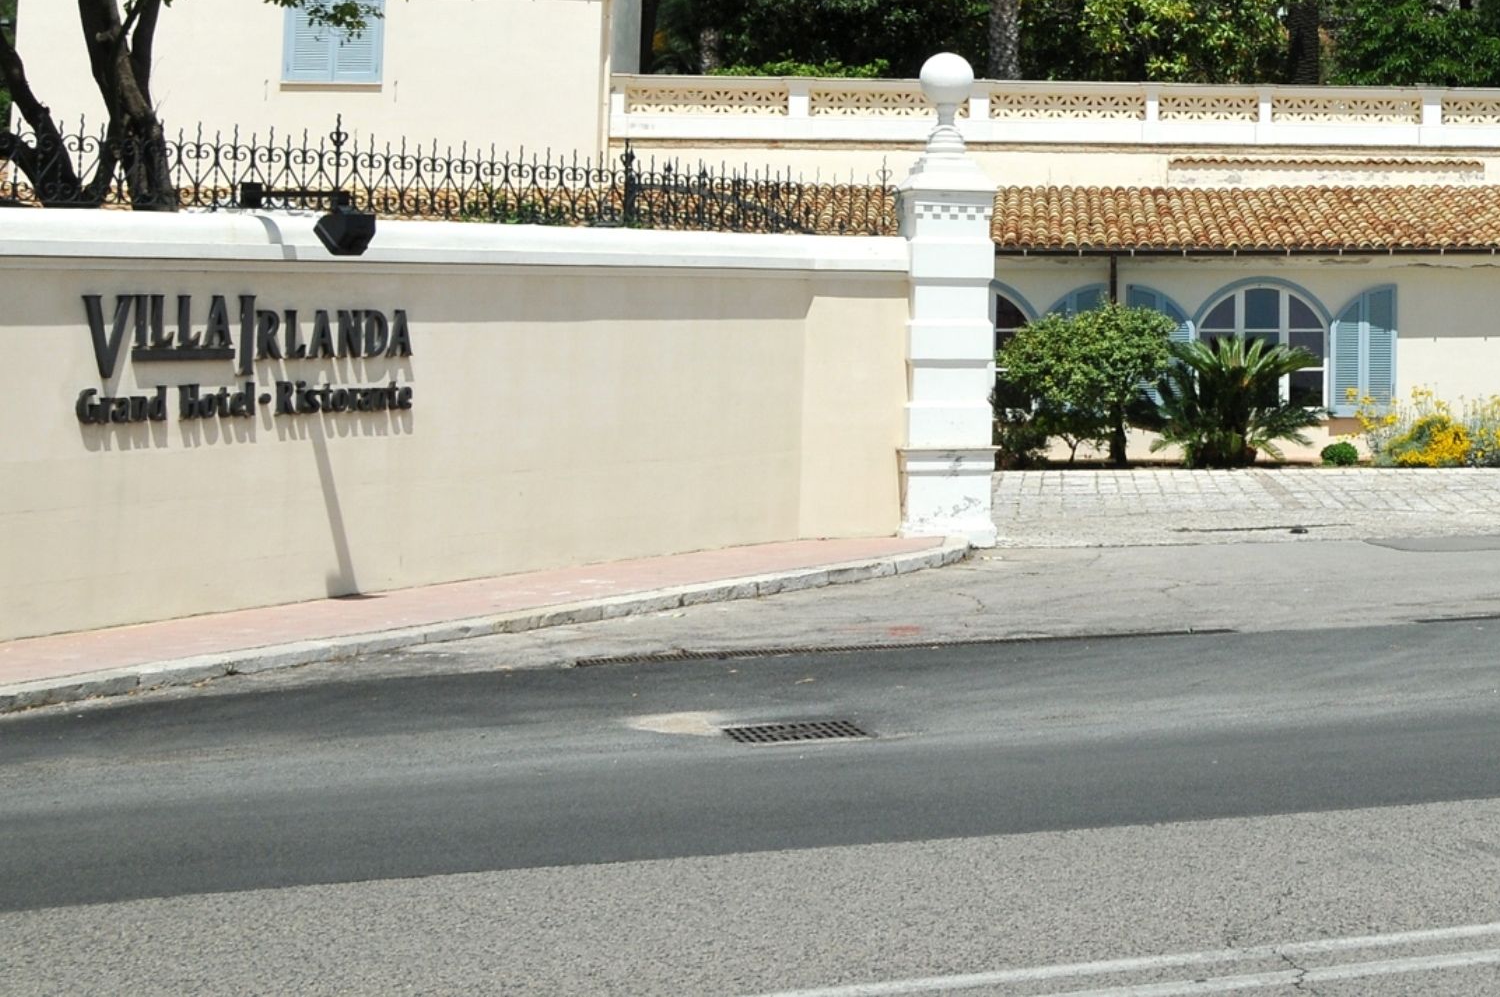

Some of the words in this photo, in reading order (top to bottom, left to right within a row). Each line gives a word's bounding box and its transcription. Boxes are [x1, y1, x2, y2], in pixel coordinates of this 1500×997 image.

[82, 295, 234, 379] VILLA
[235, 295, 413, 377] IRLANDA
[76, 385, 168, 424] Grand
[178, 382, 256, 421] Hotel
[274, 381, 413, 416] Ristorante
